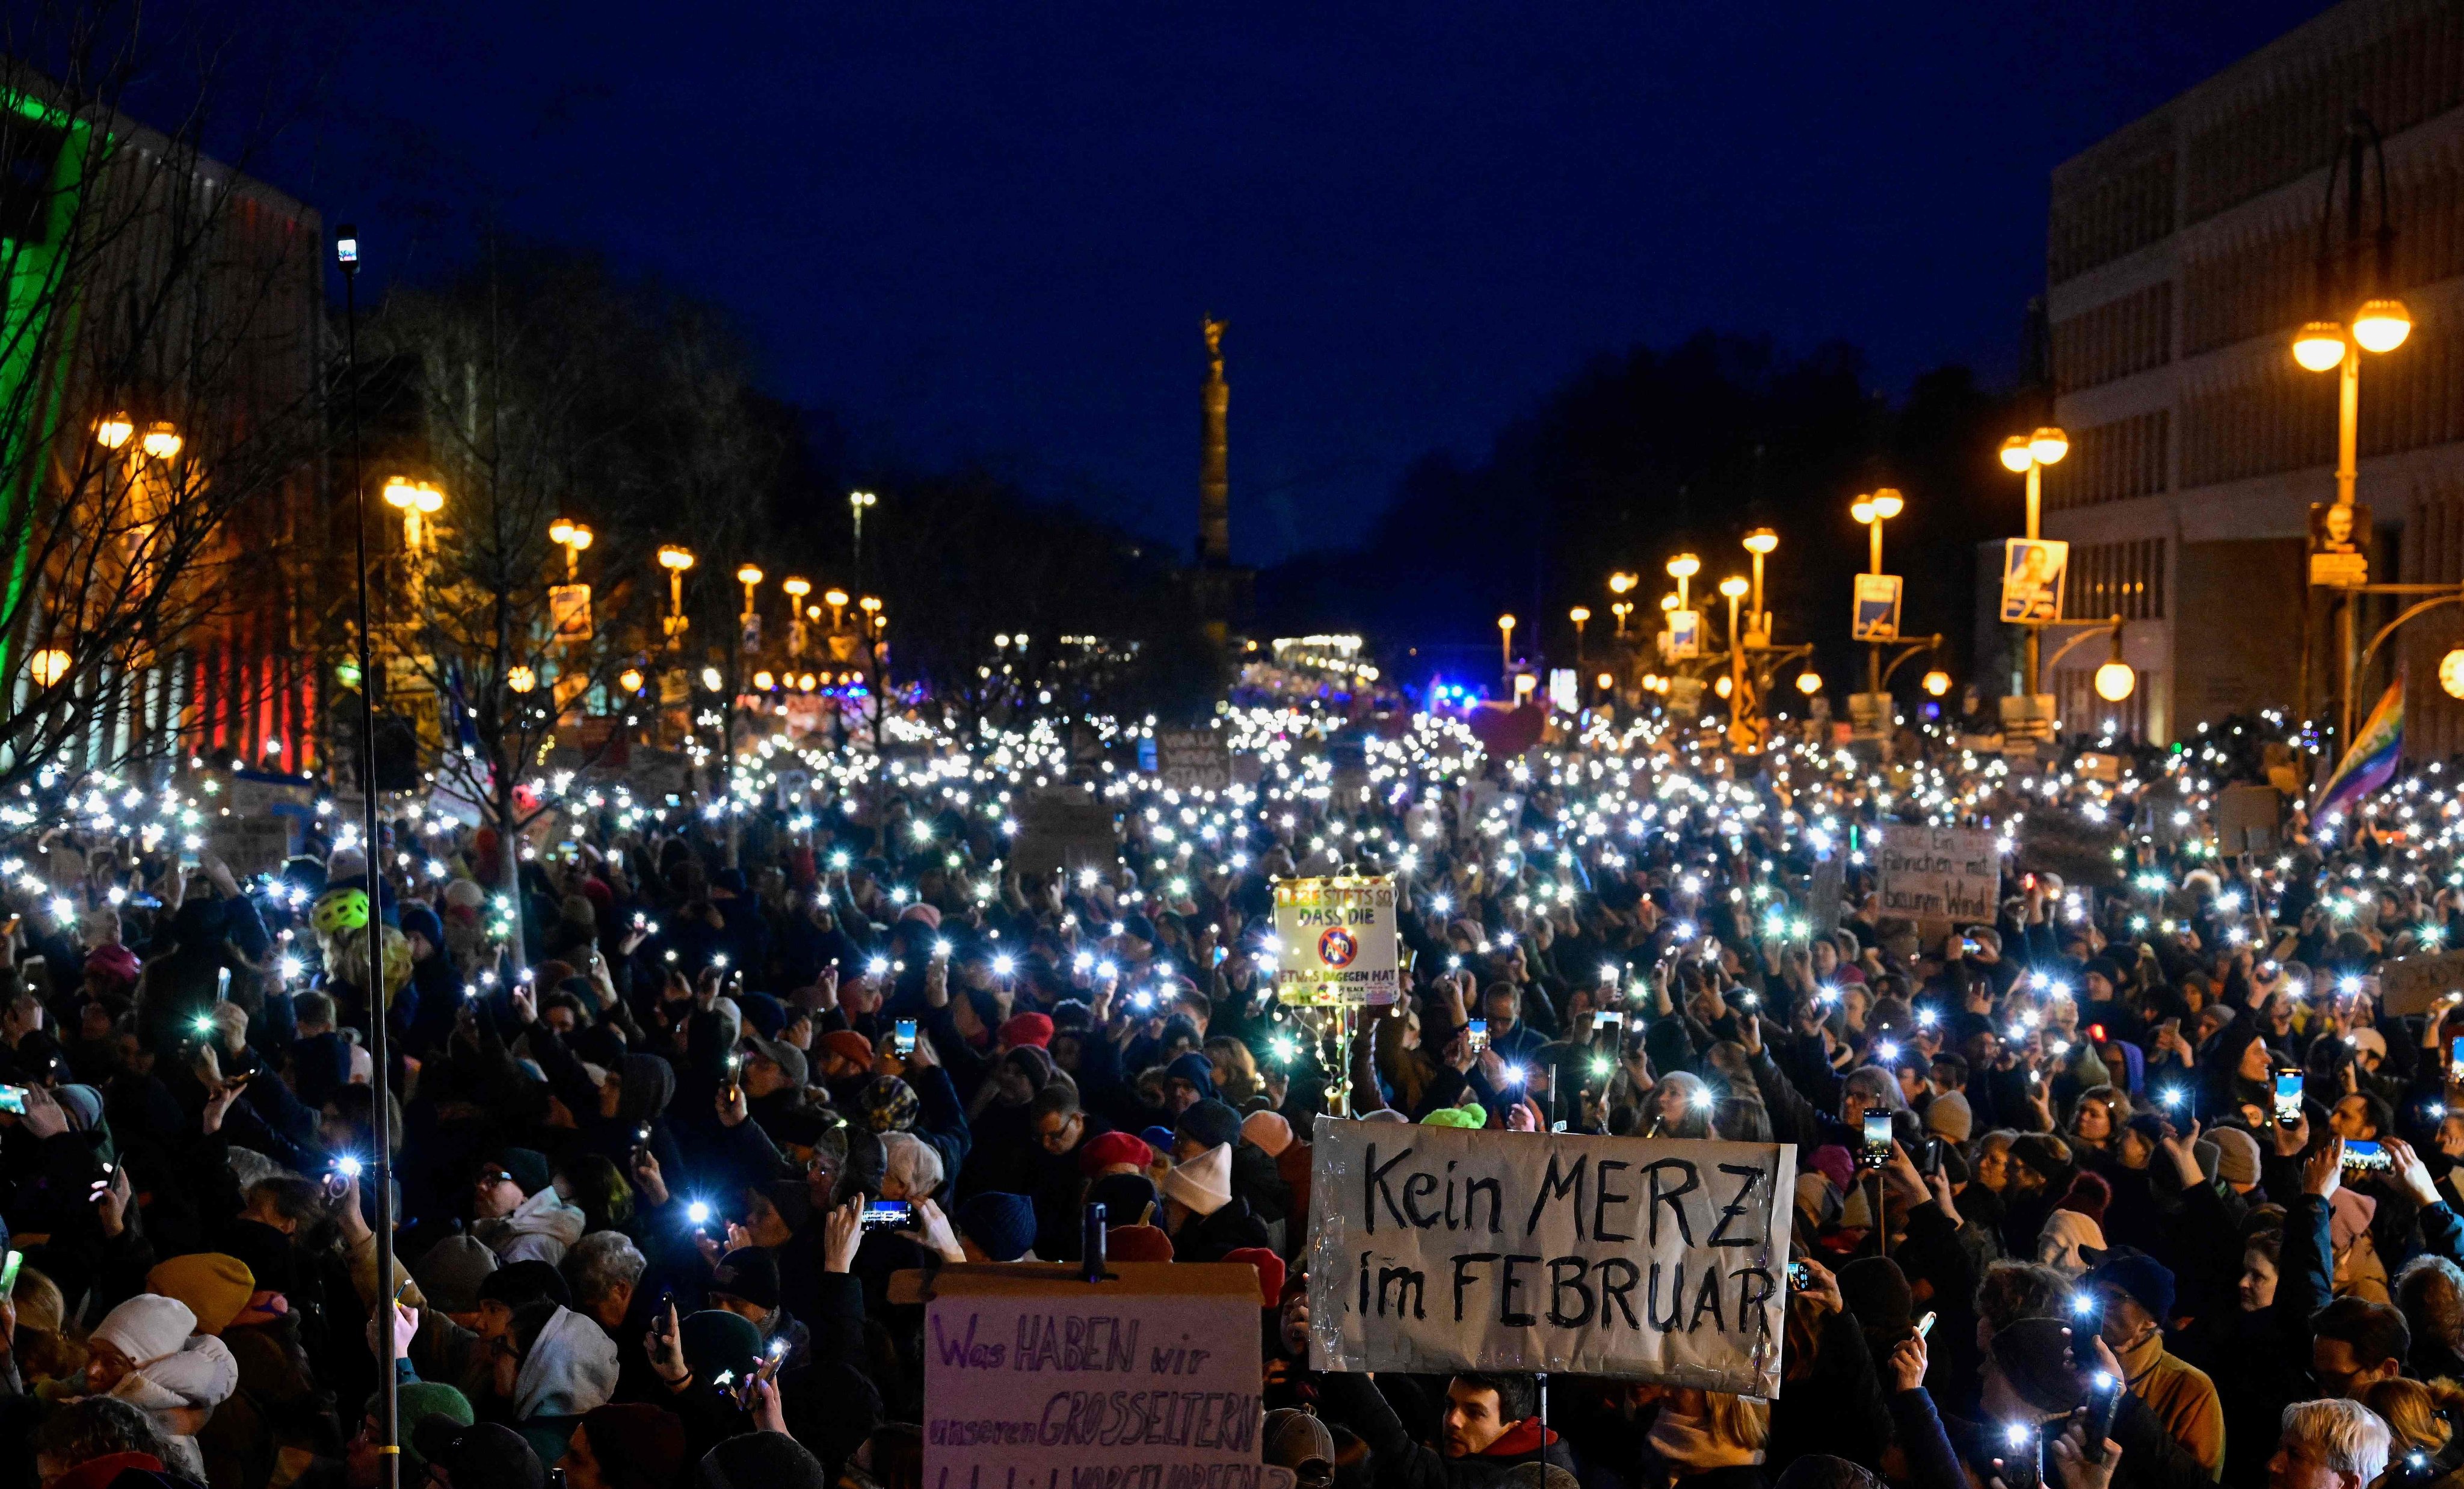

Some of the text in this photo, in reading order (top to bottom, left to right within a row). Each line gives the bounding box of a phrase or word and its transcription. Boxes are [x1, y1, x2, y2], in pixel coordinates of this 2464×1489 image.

[1299, 907, 1375, 926] DASS DIE
[1323, 888, 1373, 906] STETS
[1372, 969, 1395, 982] HAT
[1364, 1143, 1765, 1249] Kein MERZ
[1359, 1250, 1776, 1338] im FEBRUAR
[932, 1313, 1210, 1375] Was HABEN wir
[929, 1390, 1262, 1452] unseren GROSSELTERN
